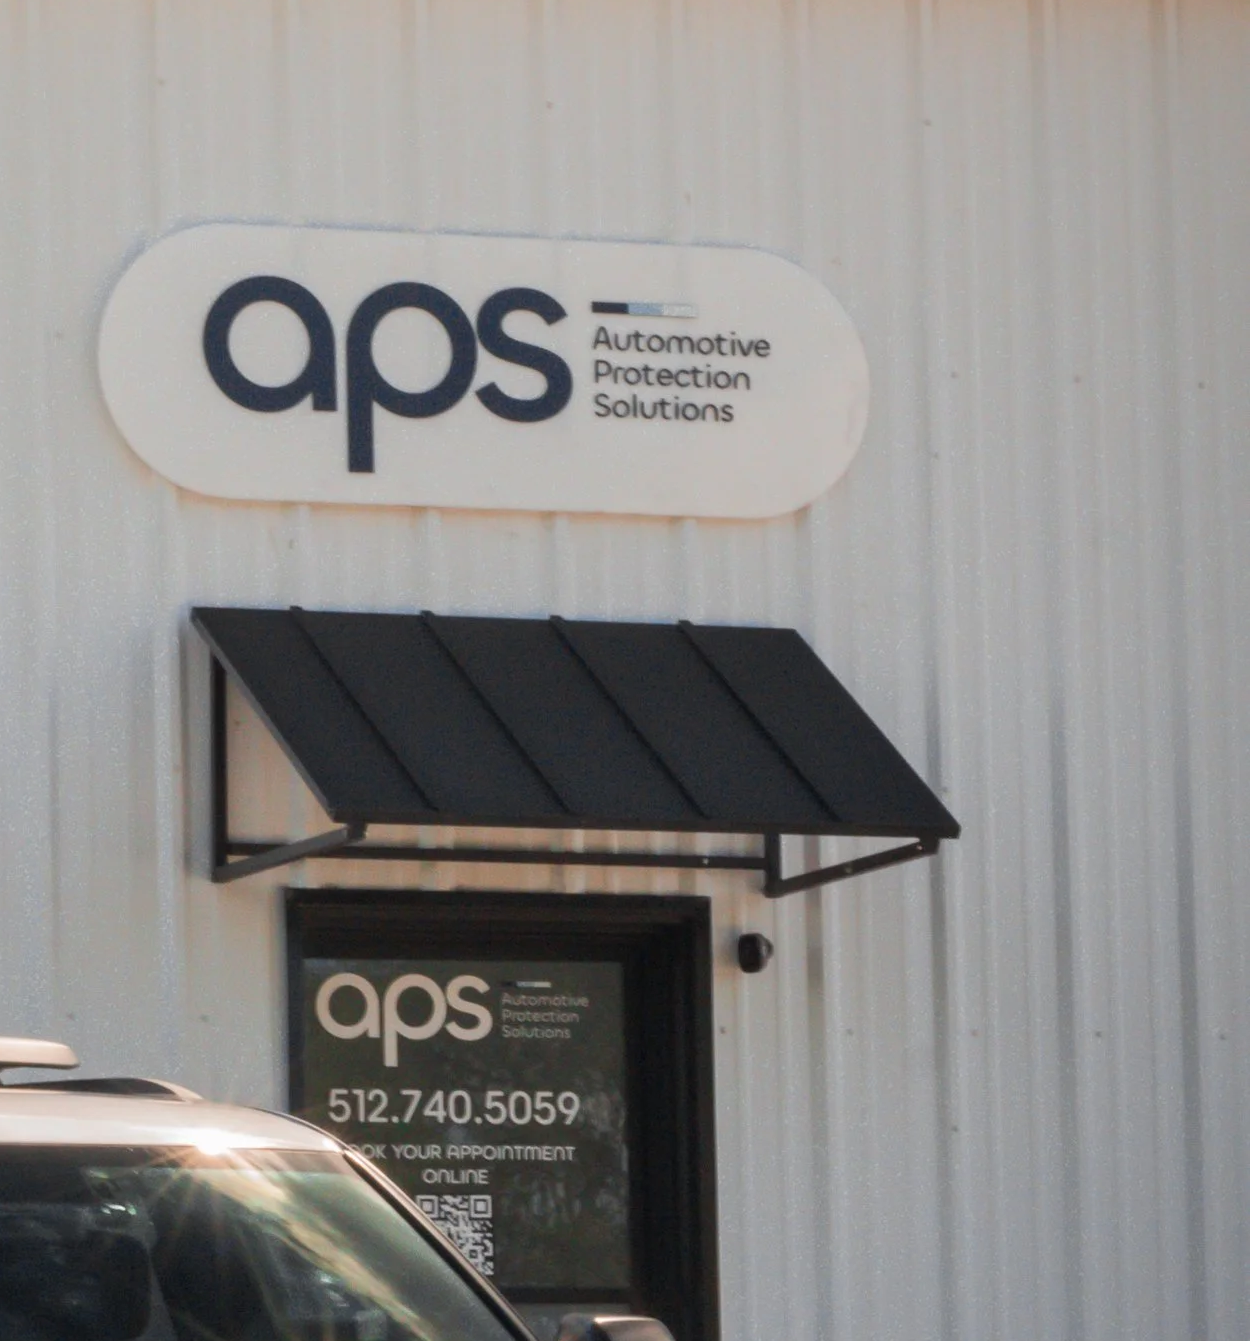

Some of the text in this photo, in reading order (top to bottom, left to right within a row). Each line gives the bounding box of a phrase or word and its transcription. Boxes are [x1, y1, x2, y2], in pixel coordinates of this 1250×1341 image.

[593, 326, 771, 358] Automotive
[203, 275, 573, 473] aps
[594, 360, 751, 390] Protection
[594, 393, 735, 422] Solutions
[501, 992, 589, 1007] Automotive
[316, 972, 494, 1068] aps
[502, 1009, 580, 1023] Protection
[502, 1025, 571, 1039] Solutions
[328, 1088, 581, 1126] 512.740.5059
[349, 1143, 576, 1161] OK YOUR APPOINTMENT
[422, 1168, 489, 1185] ONLINE
